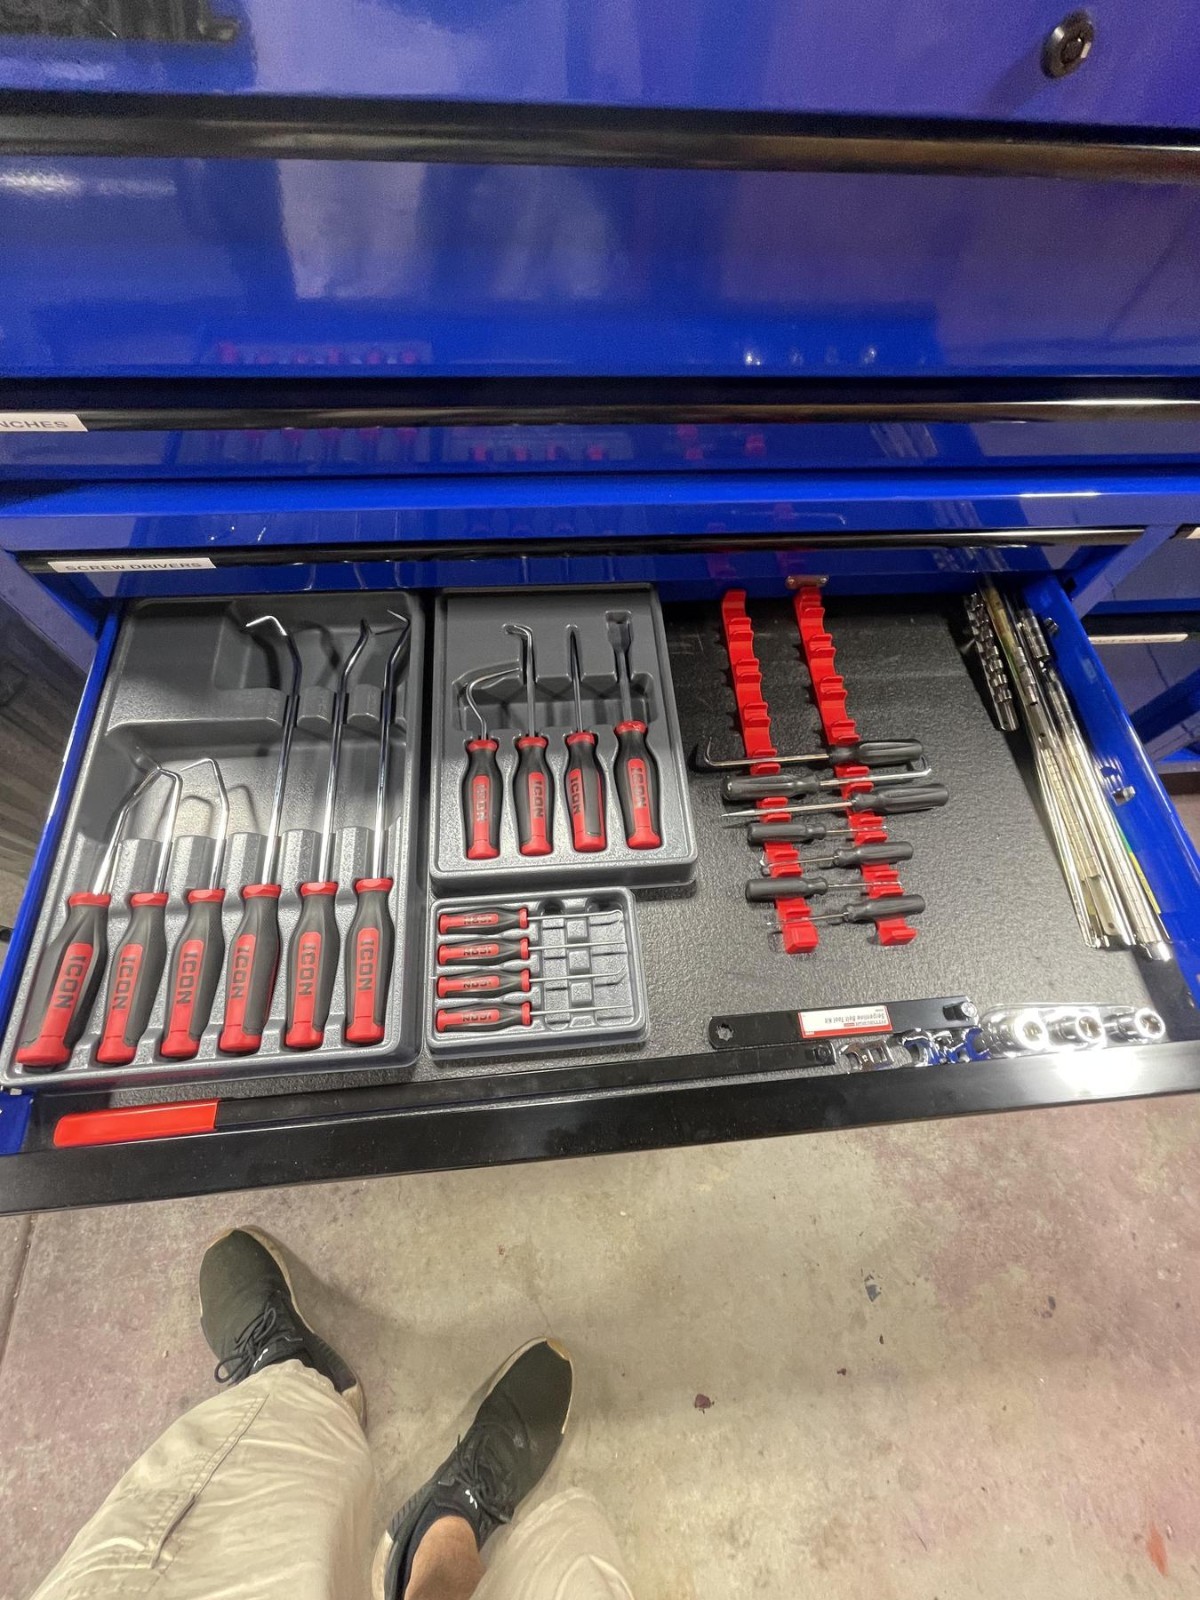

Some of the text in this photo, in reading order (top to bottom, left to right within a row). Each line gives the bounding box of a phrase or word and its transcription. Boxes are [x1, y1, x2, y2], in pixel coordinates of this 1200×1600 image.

[129, 562, 202, 570] DRIVERS
[533, 780, 544, 818] ICON
[570, 777, 581, 814] ICON
[631, 767, 647, 808] ICON
[54, 956, 87, 1009] ICON
[111, 956, 137, 1010] ICON
[176, 952, 198, 1006] ICON
[230, 947, 250, 1000] ICON
[300, 943, 317, 996] ICON
[359, 940, 375, 991] ICON
[857, 1012, 885, 1021] Serpentine
